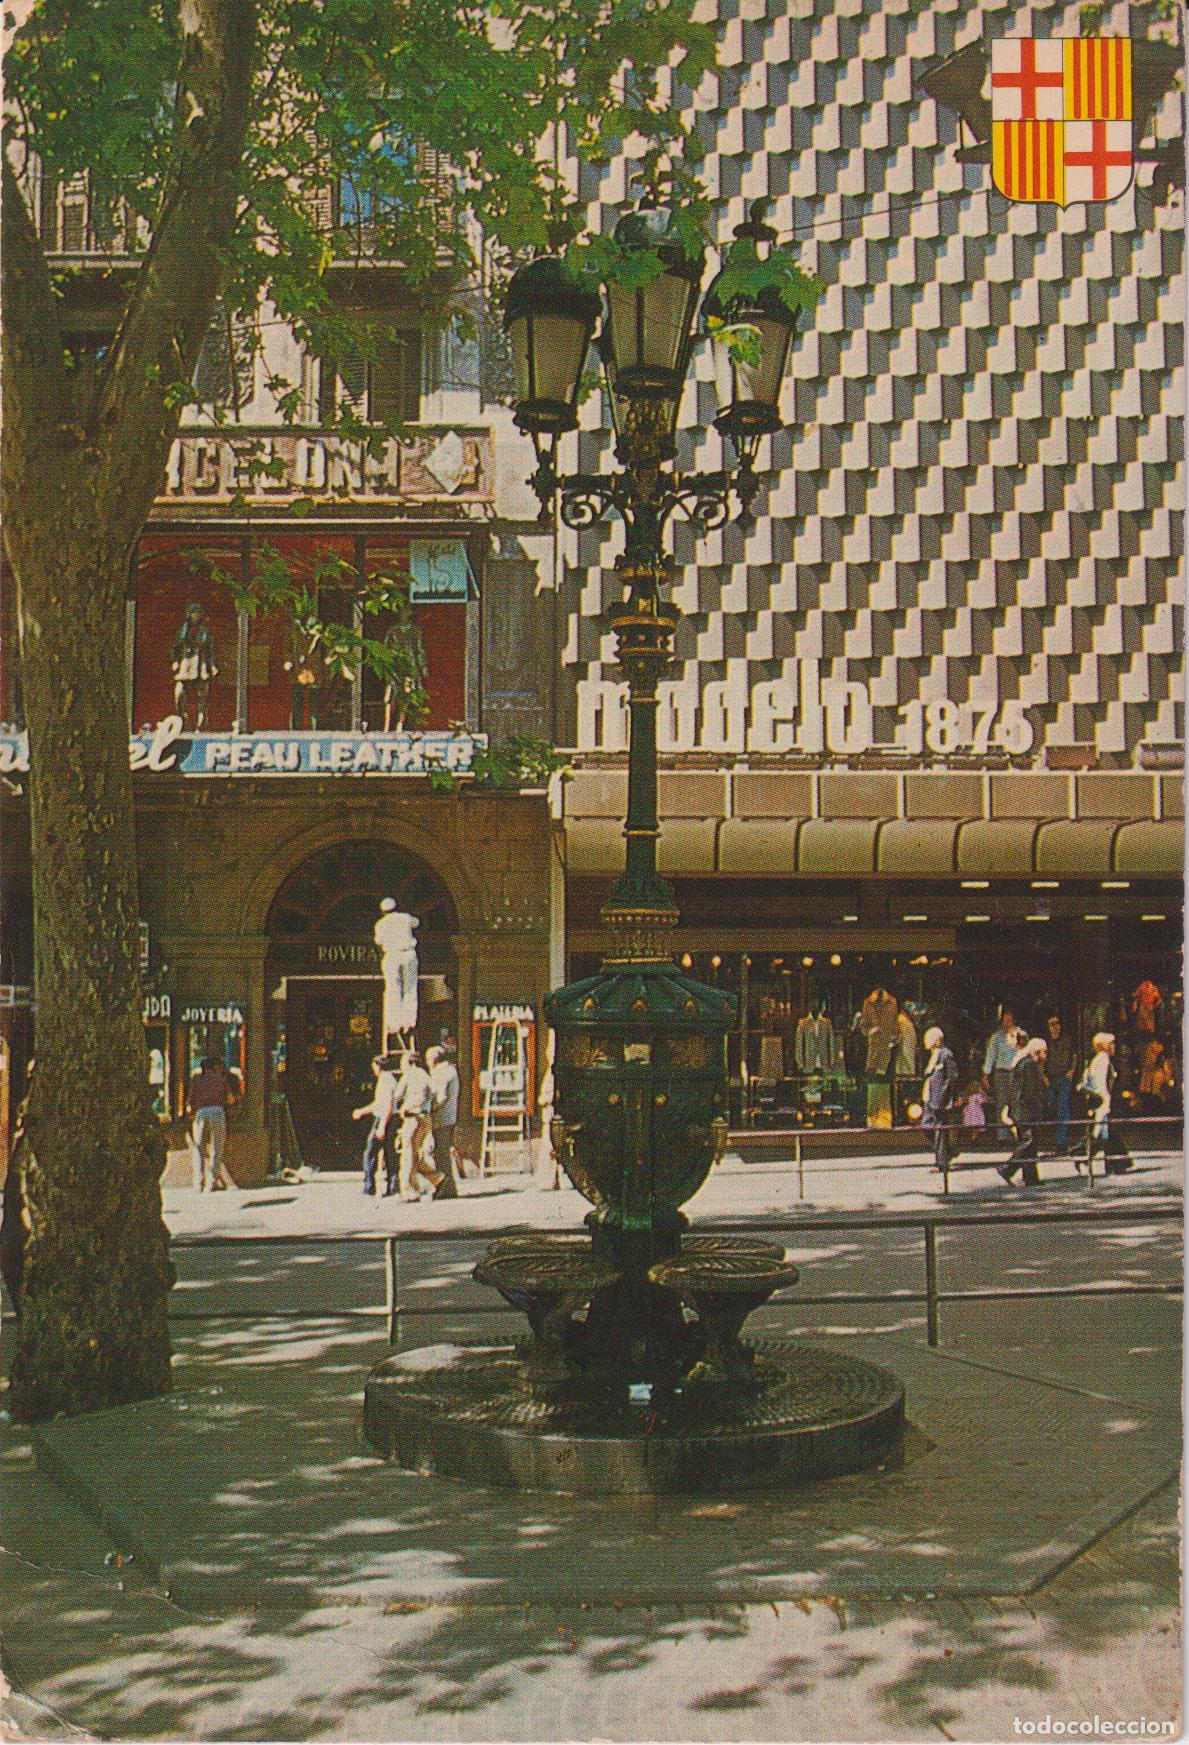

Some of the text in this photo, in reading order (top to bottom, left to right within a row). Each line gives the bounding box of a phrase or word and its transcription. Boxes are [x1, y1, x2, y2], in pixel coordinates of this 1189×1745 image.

[898, 699, 1034, 755] 1875
[205, 742, 473, 773] PEAU LEATHER
